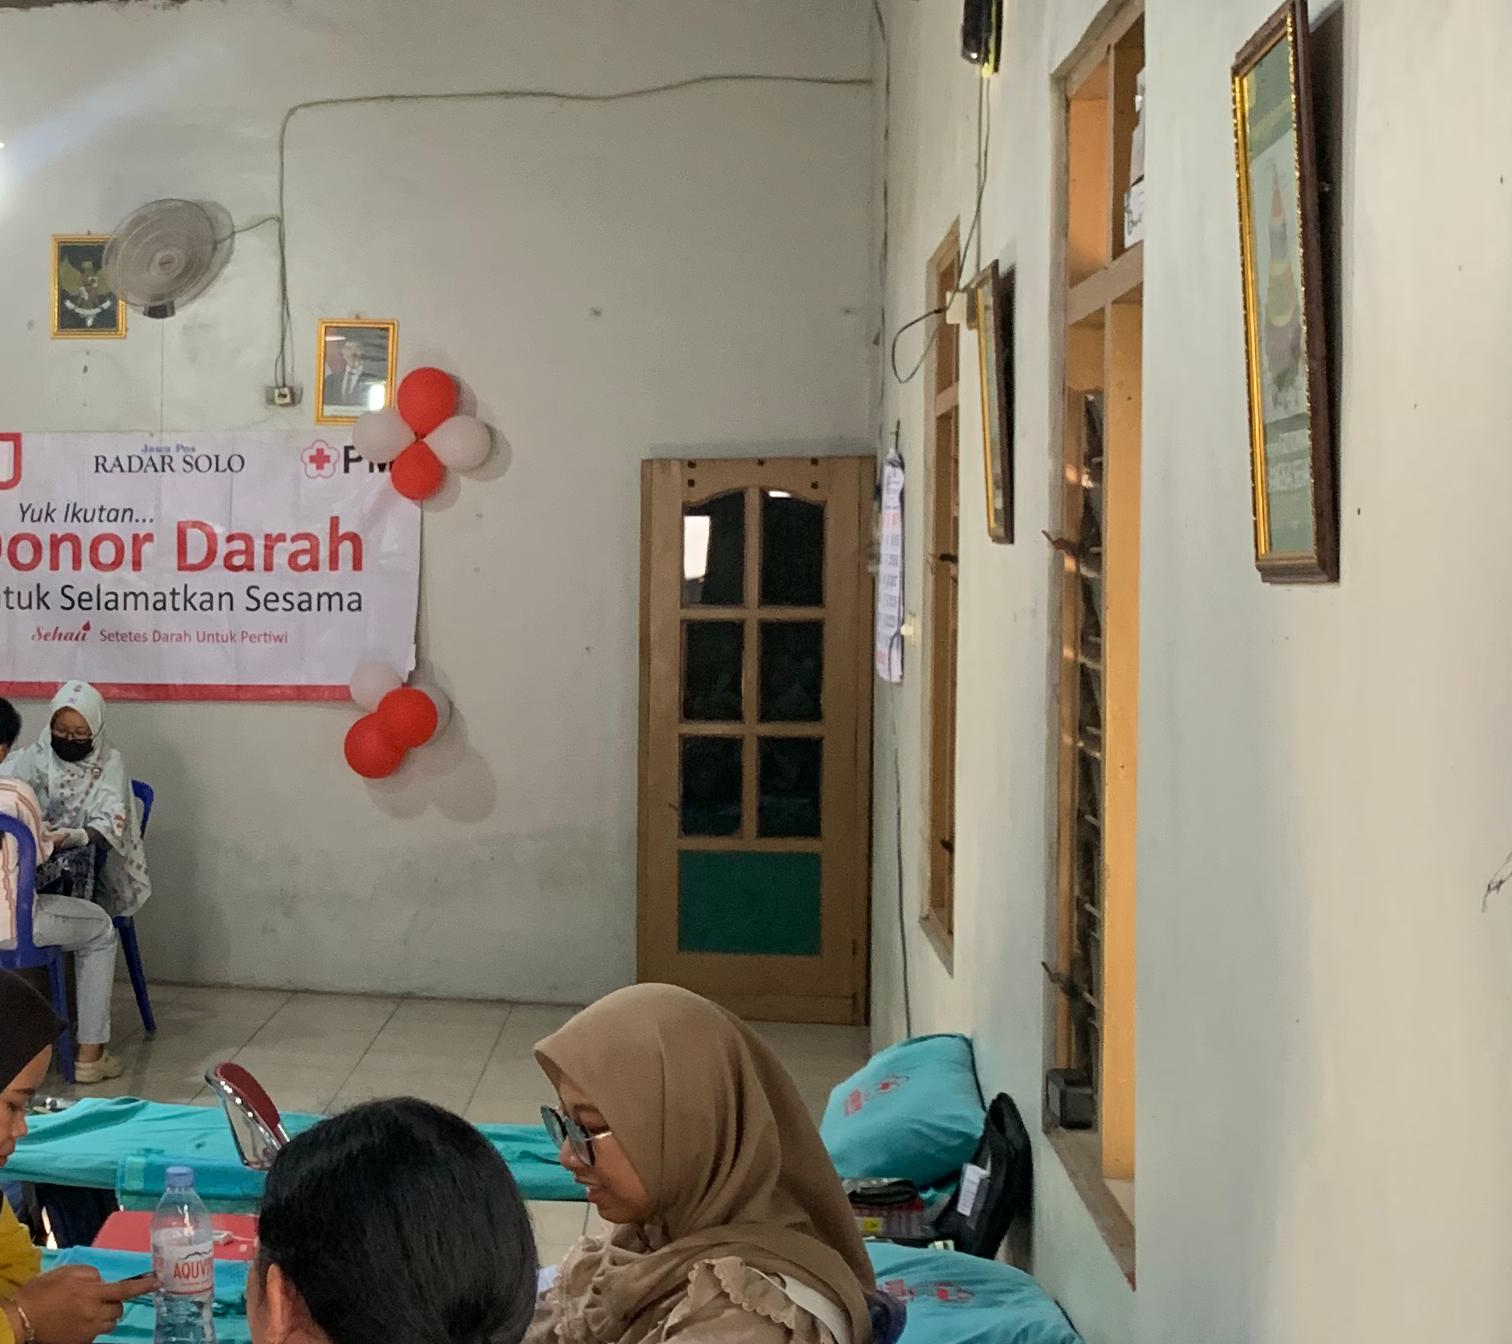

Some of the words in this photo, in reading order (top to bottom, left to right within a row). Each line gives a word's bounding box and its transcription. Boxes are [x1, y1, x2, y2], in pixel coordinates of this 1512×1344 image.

[141, 443, 171, 454] Jawa
[175, 443, 196, 454] Pos
[93, 454, 176, 474] RADAR
[181, 453, 246, 474] SOLO
[19, 501, 57, 524] Yuk
[63, 501, 155, 524] Ikutan...
[175, 516, 364, 573] Darah
[59, 583, 235, 612] Selamatkan
[245, 584, 363, 613] Sesama
[98, 629, 149, 643] Setetes
[151, 629, 192, 643] Darah
[195, 629, 238, 643] Untuk
[240, 629, 289, 644] Pertiwi
